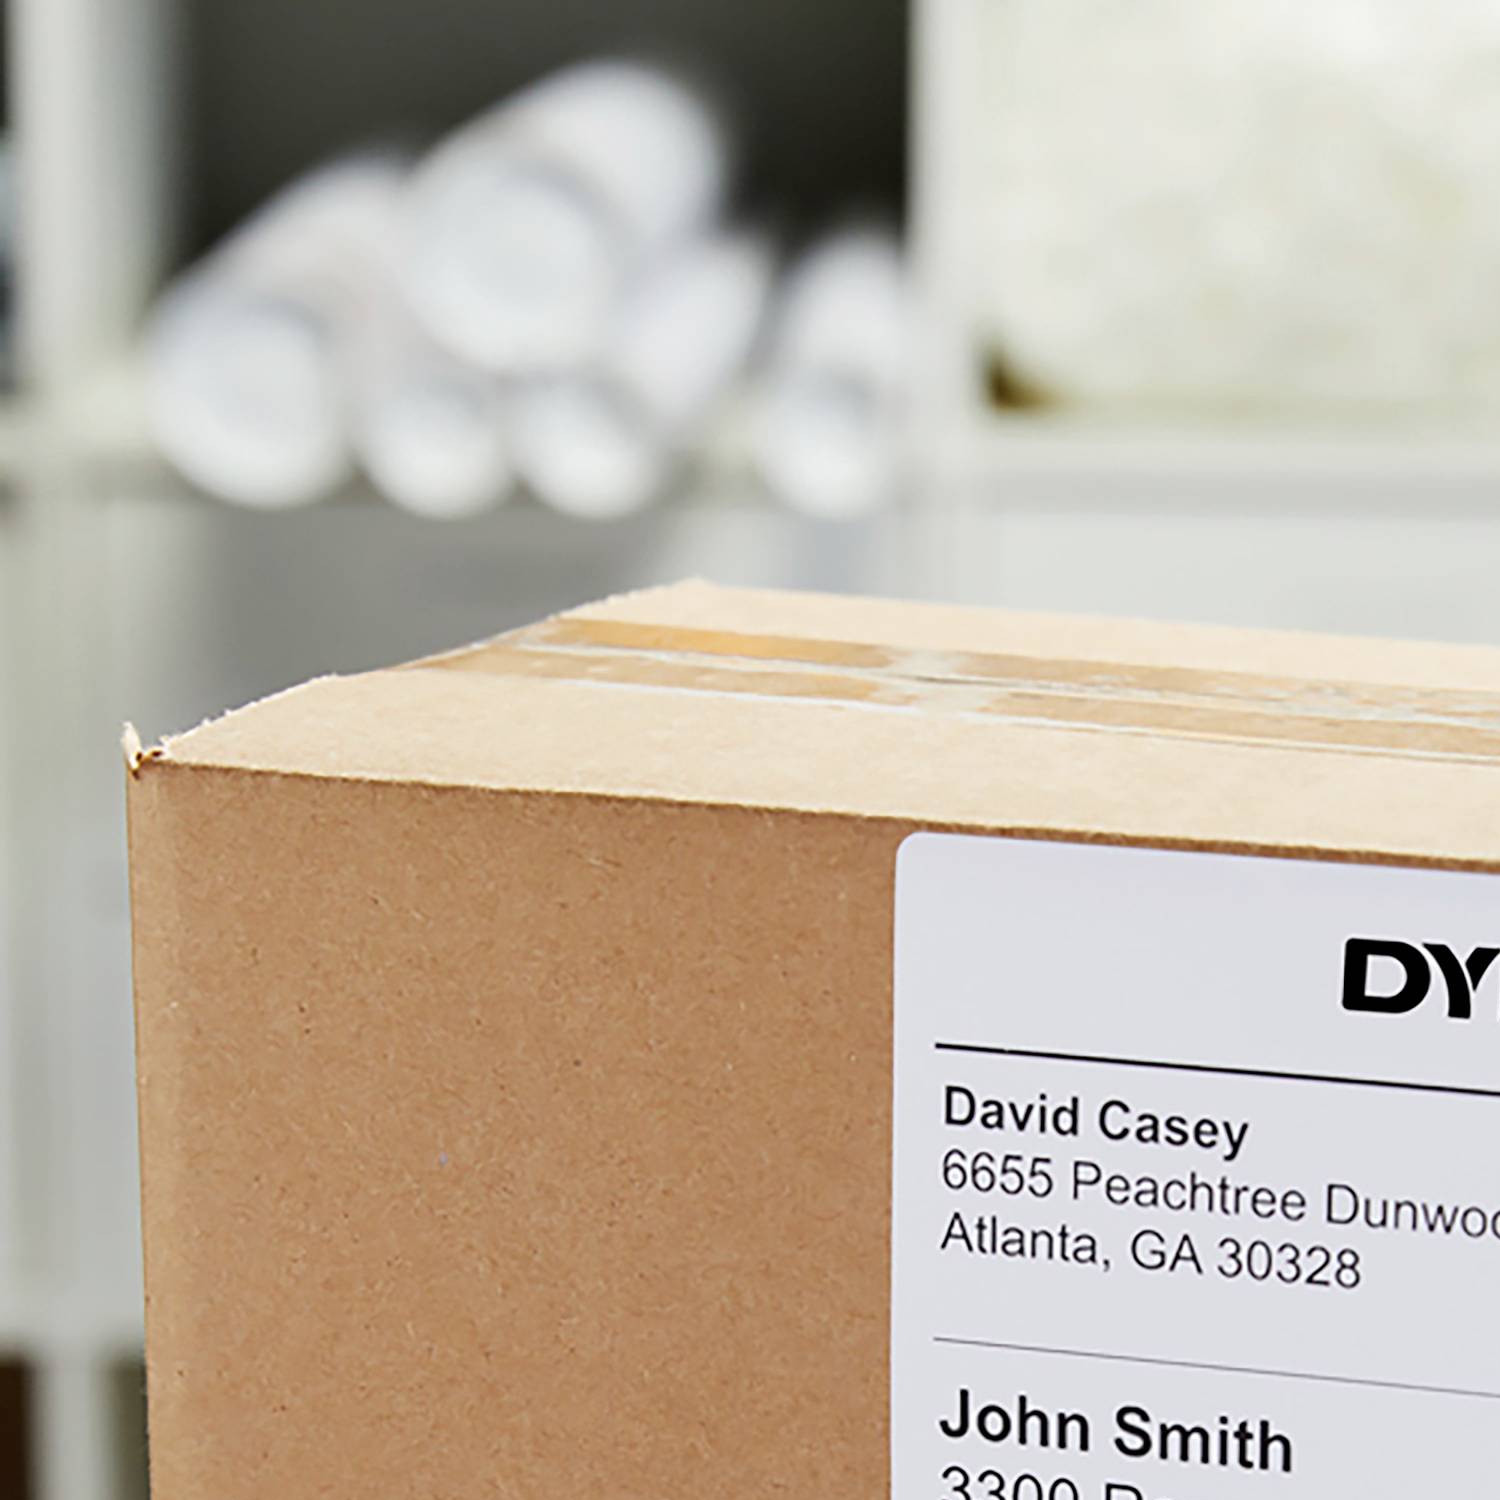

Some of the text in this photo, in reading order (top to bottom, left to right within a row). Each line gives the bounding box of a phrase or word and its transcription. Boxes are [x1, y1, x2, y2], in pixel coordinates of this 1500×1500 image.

[944, 1084, 1249, 1161] David Casey
[942, 1148, 1054, 1199] 6655
[1072, 1160, 1307, 1222] Peachtree
[940, 1211, 1361, 1290] Atlanta, GA 30328
[938, 1388, 1292, 1474] John Smith
